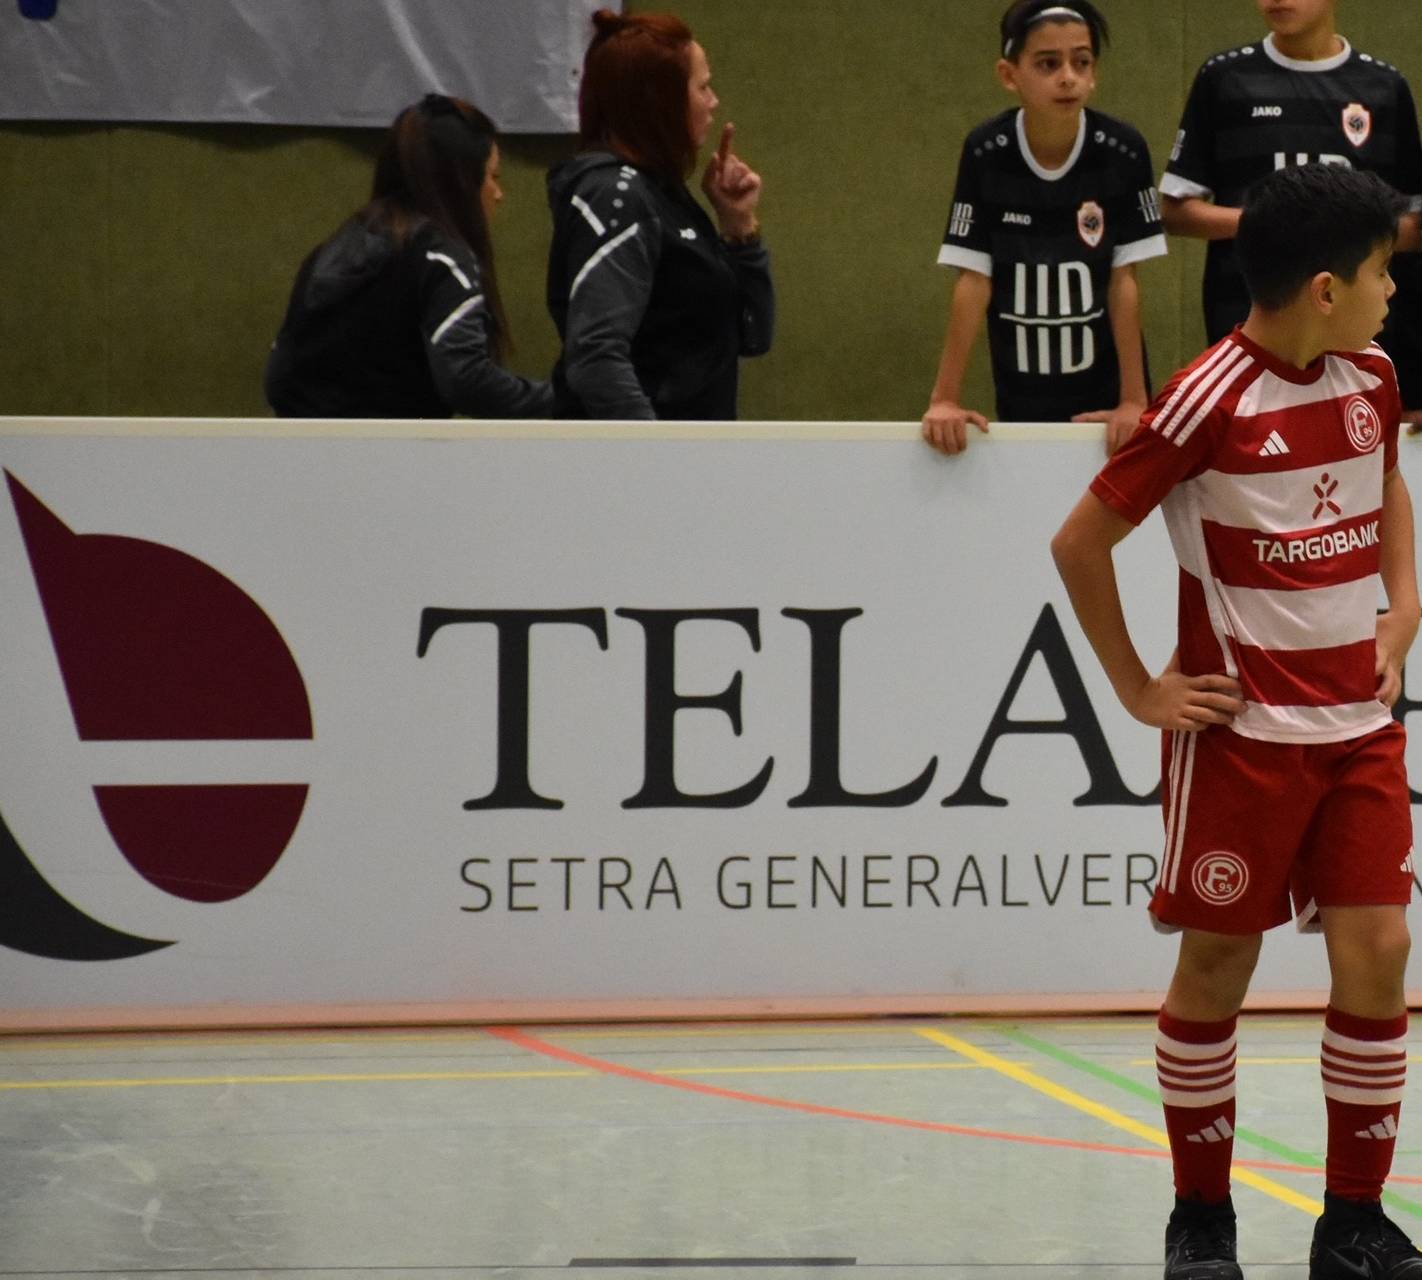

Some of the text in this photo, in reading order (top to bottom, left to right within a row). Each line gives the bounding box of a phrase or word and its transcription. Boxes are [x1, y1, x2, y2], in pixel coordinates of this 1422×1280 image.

[1252, 106, 1282, 117] JAKO
[1002, 212, 1032, 225] JAKO
[1253, 521, 1380, 563] TARGOBANK
[459, 857, 682, 912] SETRA
